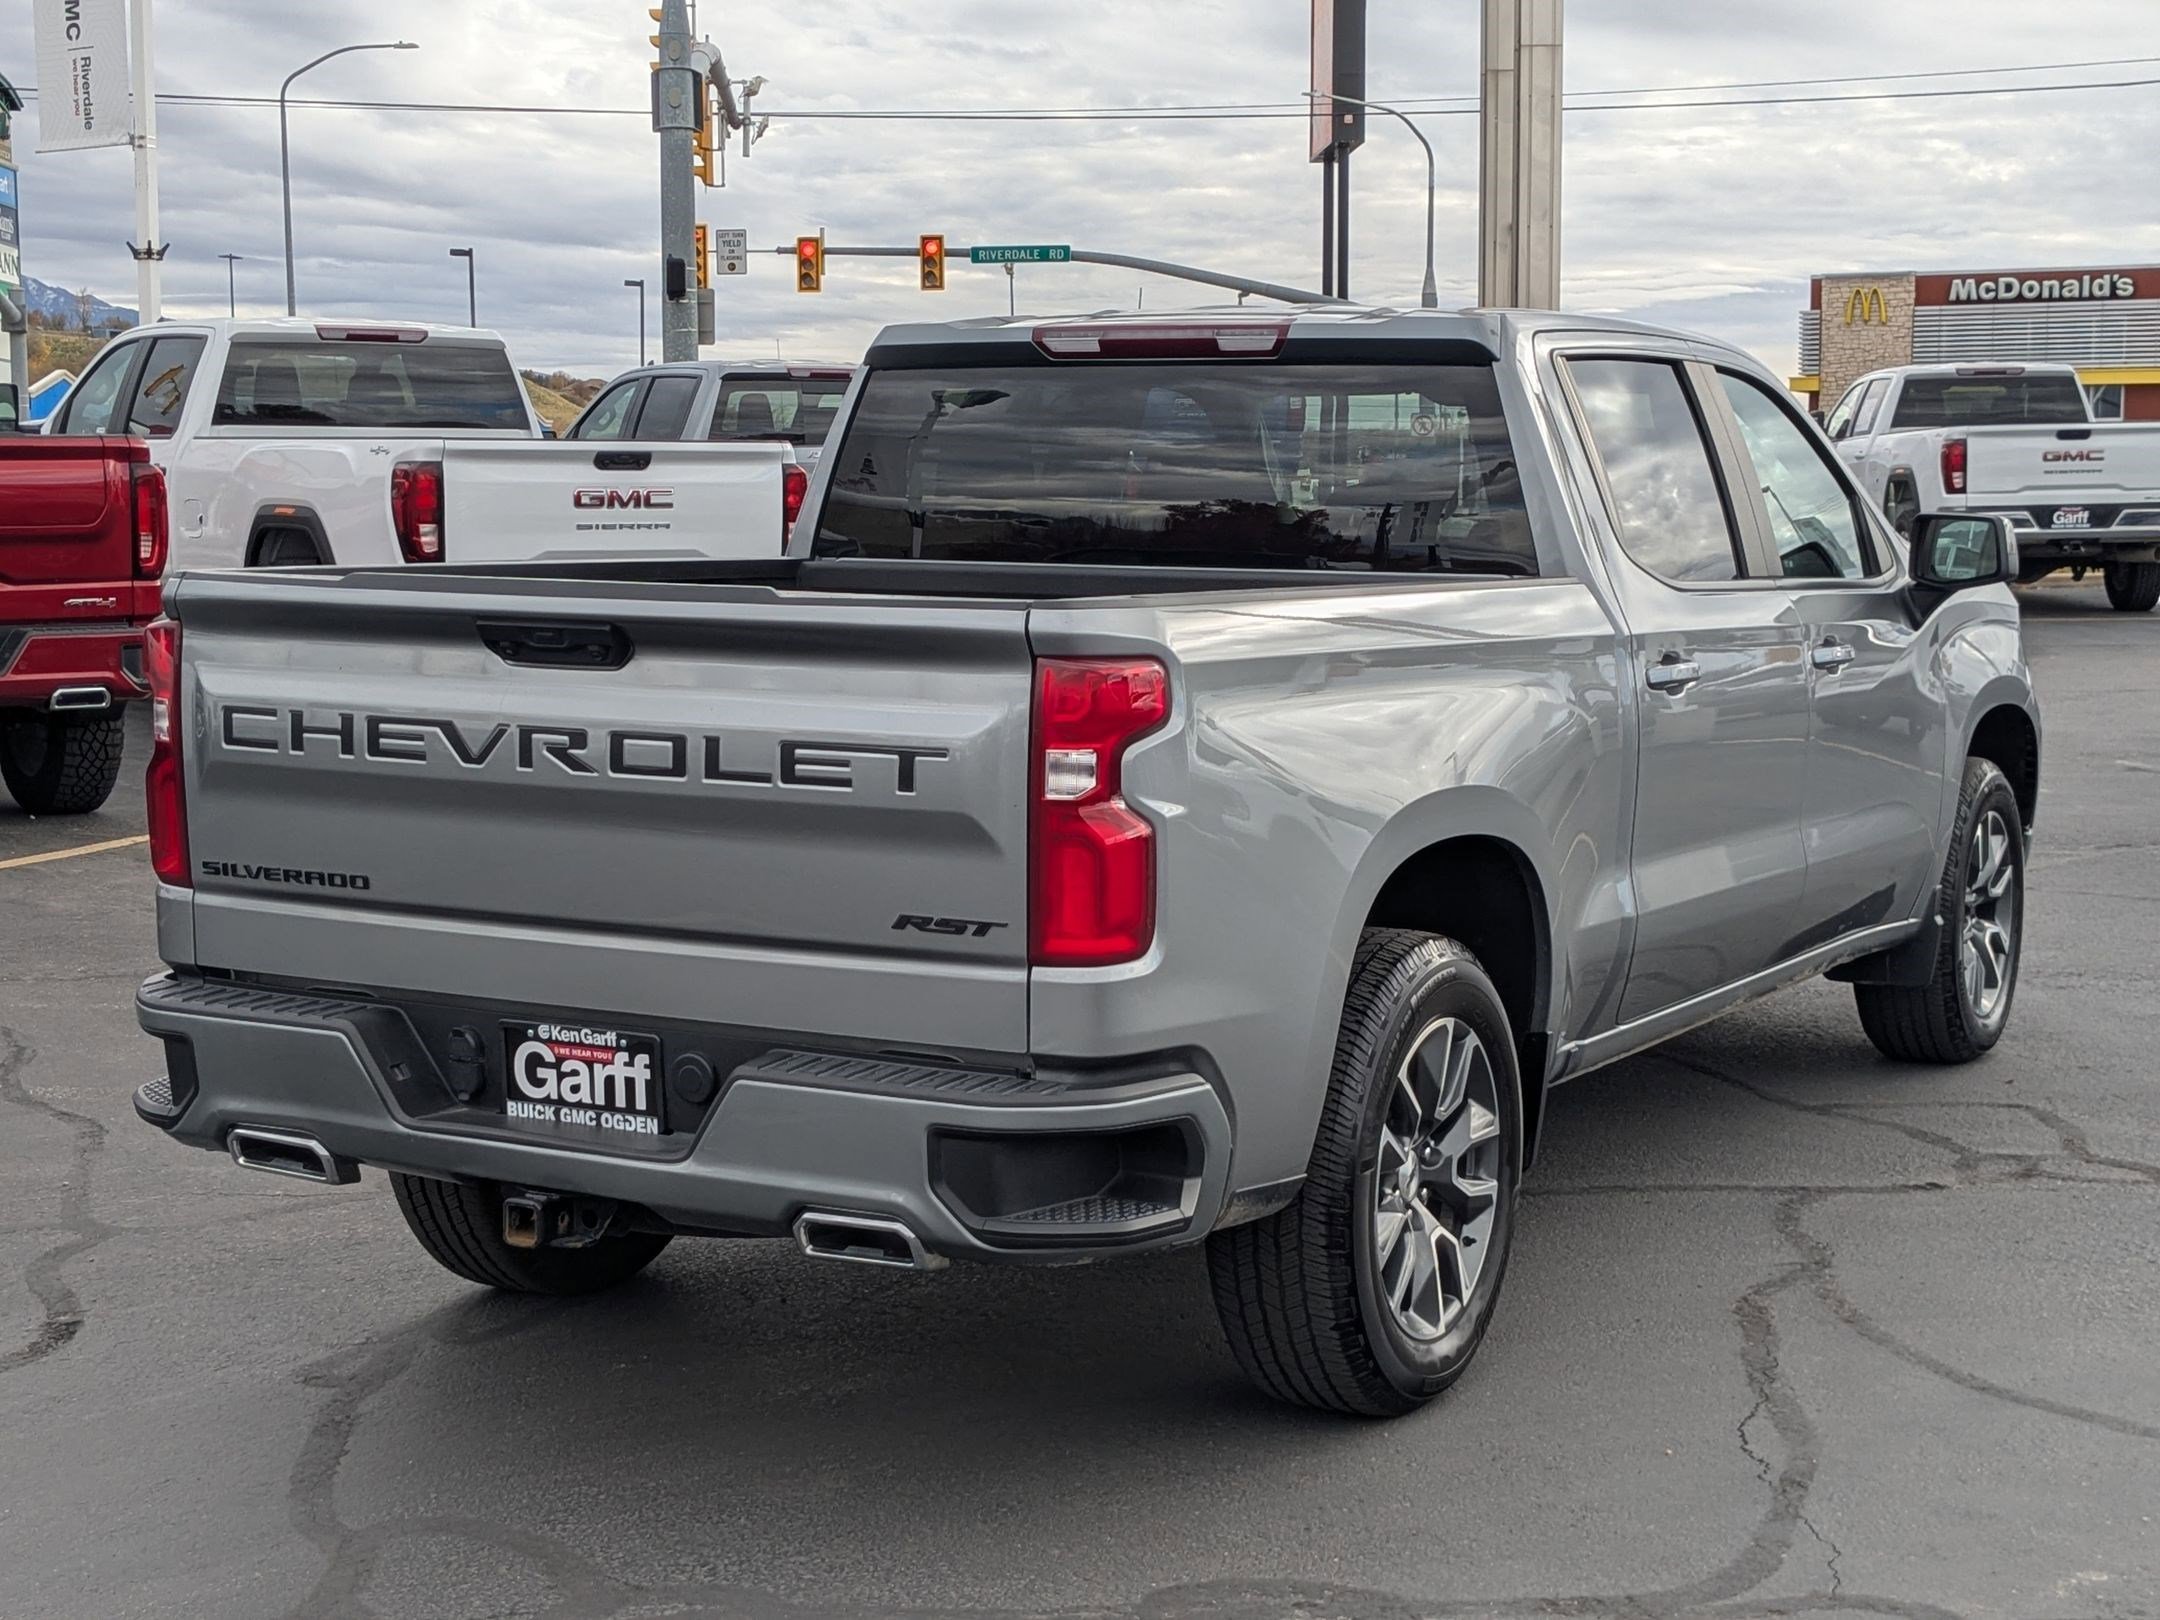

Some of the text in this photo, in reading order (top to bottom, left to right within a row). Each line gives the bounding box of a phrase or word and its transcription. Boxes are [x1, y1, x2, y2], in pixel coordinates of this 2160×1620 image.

[80, 56, 94, 131] Riverdale
[721, 239, 742, 248] YIELD
[978, 248, 1065, 261] RIVERDALE RD
[1948, 273, 2135, 301] McDonald's
[2042, 450, 2105, 462] GMC
[574, 487, 675, 509] GMC
[576, 523, 671, 531] SIERRA
[2053, 510, 2090, 524] Garff
[221, 705, 949, 796] CHEVROLET
[201, 860, 371, 890] SILVERADO
[890, 913, 1009, 938] RST
[560, 1047, 608, 1060] WE HEAR YOU
[513, 1040, 652, 1111] Garff
[506, 1101, 659, 1135] BUICK GMC OGDEN
